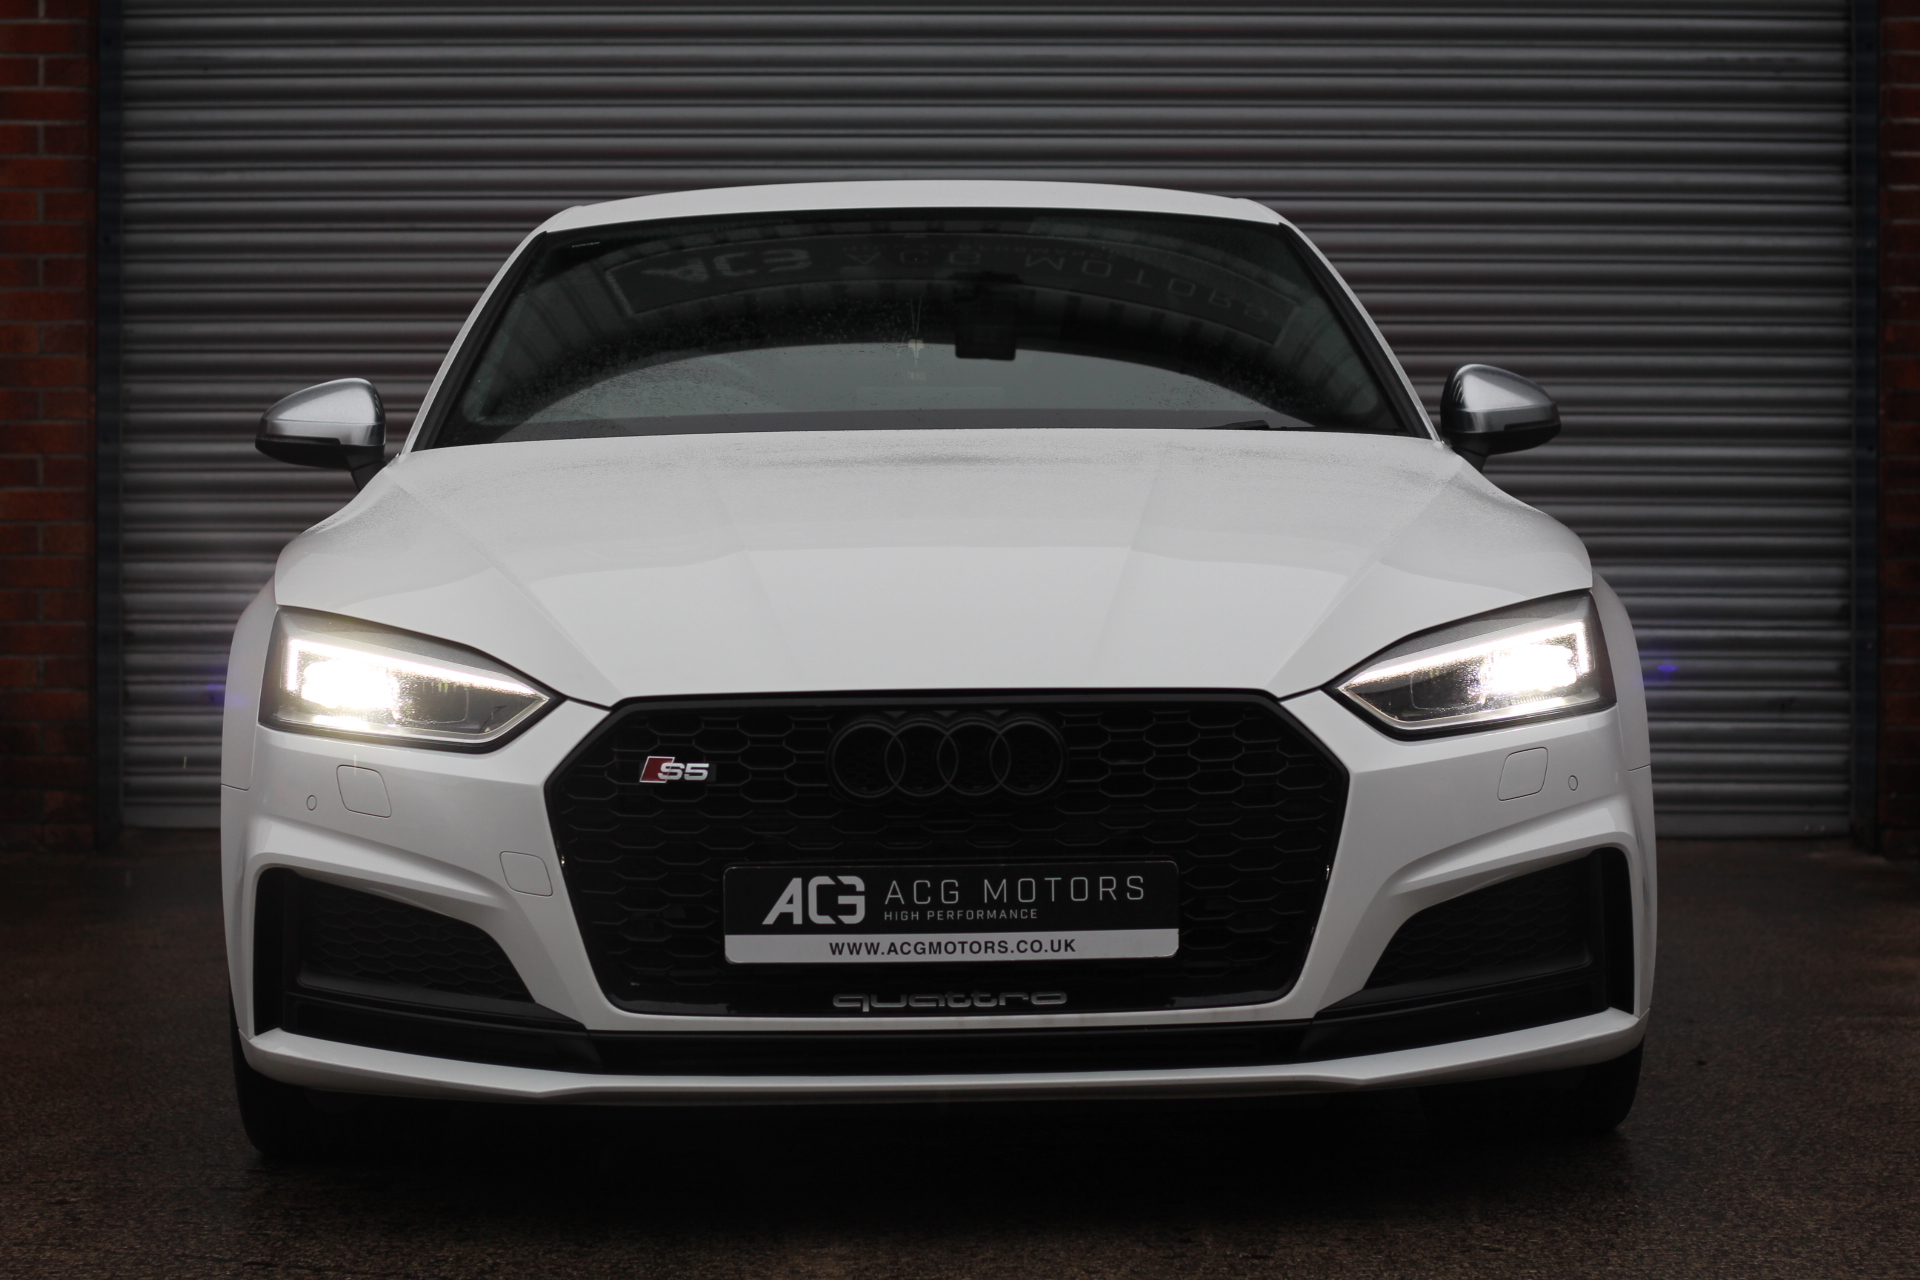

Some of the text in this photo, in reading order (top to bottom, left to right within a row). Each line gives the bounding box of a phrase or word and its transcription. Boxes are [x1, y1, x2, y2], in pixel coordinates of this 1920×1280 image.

[657, 762, 709, 781] S5
[761, 875, 866, 925] ACG
[884, 875, 1146, 905] ACG MOTORS
[884, 908, 1038, 921] HIGH PERFORMANCE
[829, 938, 1077, 956] WWW.ACGMOTORS.CO.UK
[832, 990, 1068, 1013] quattro
